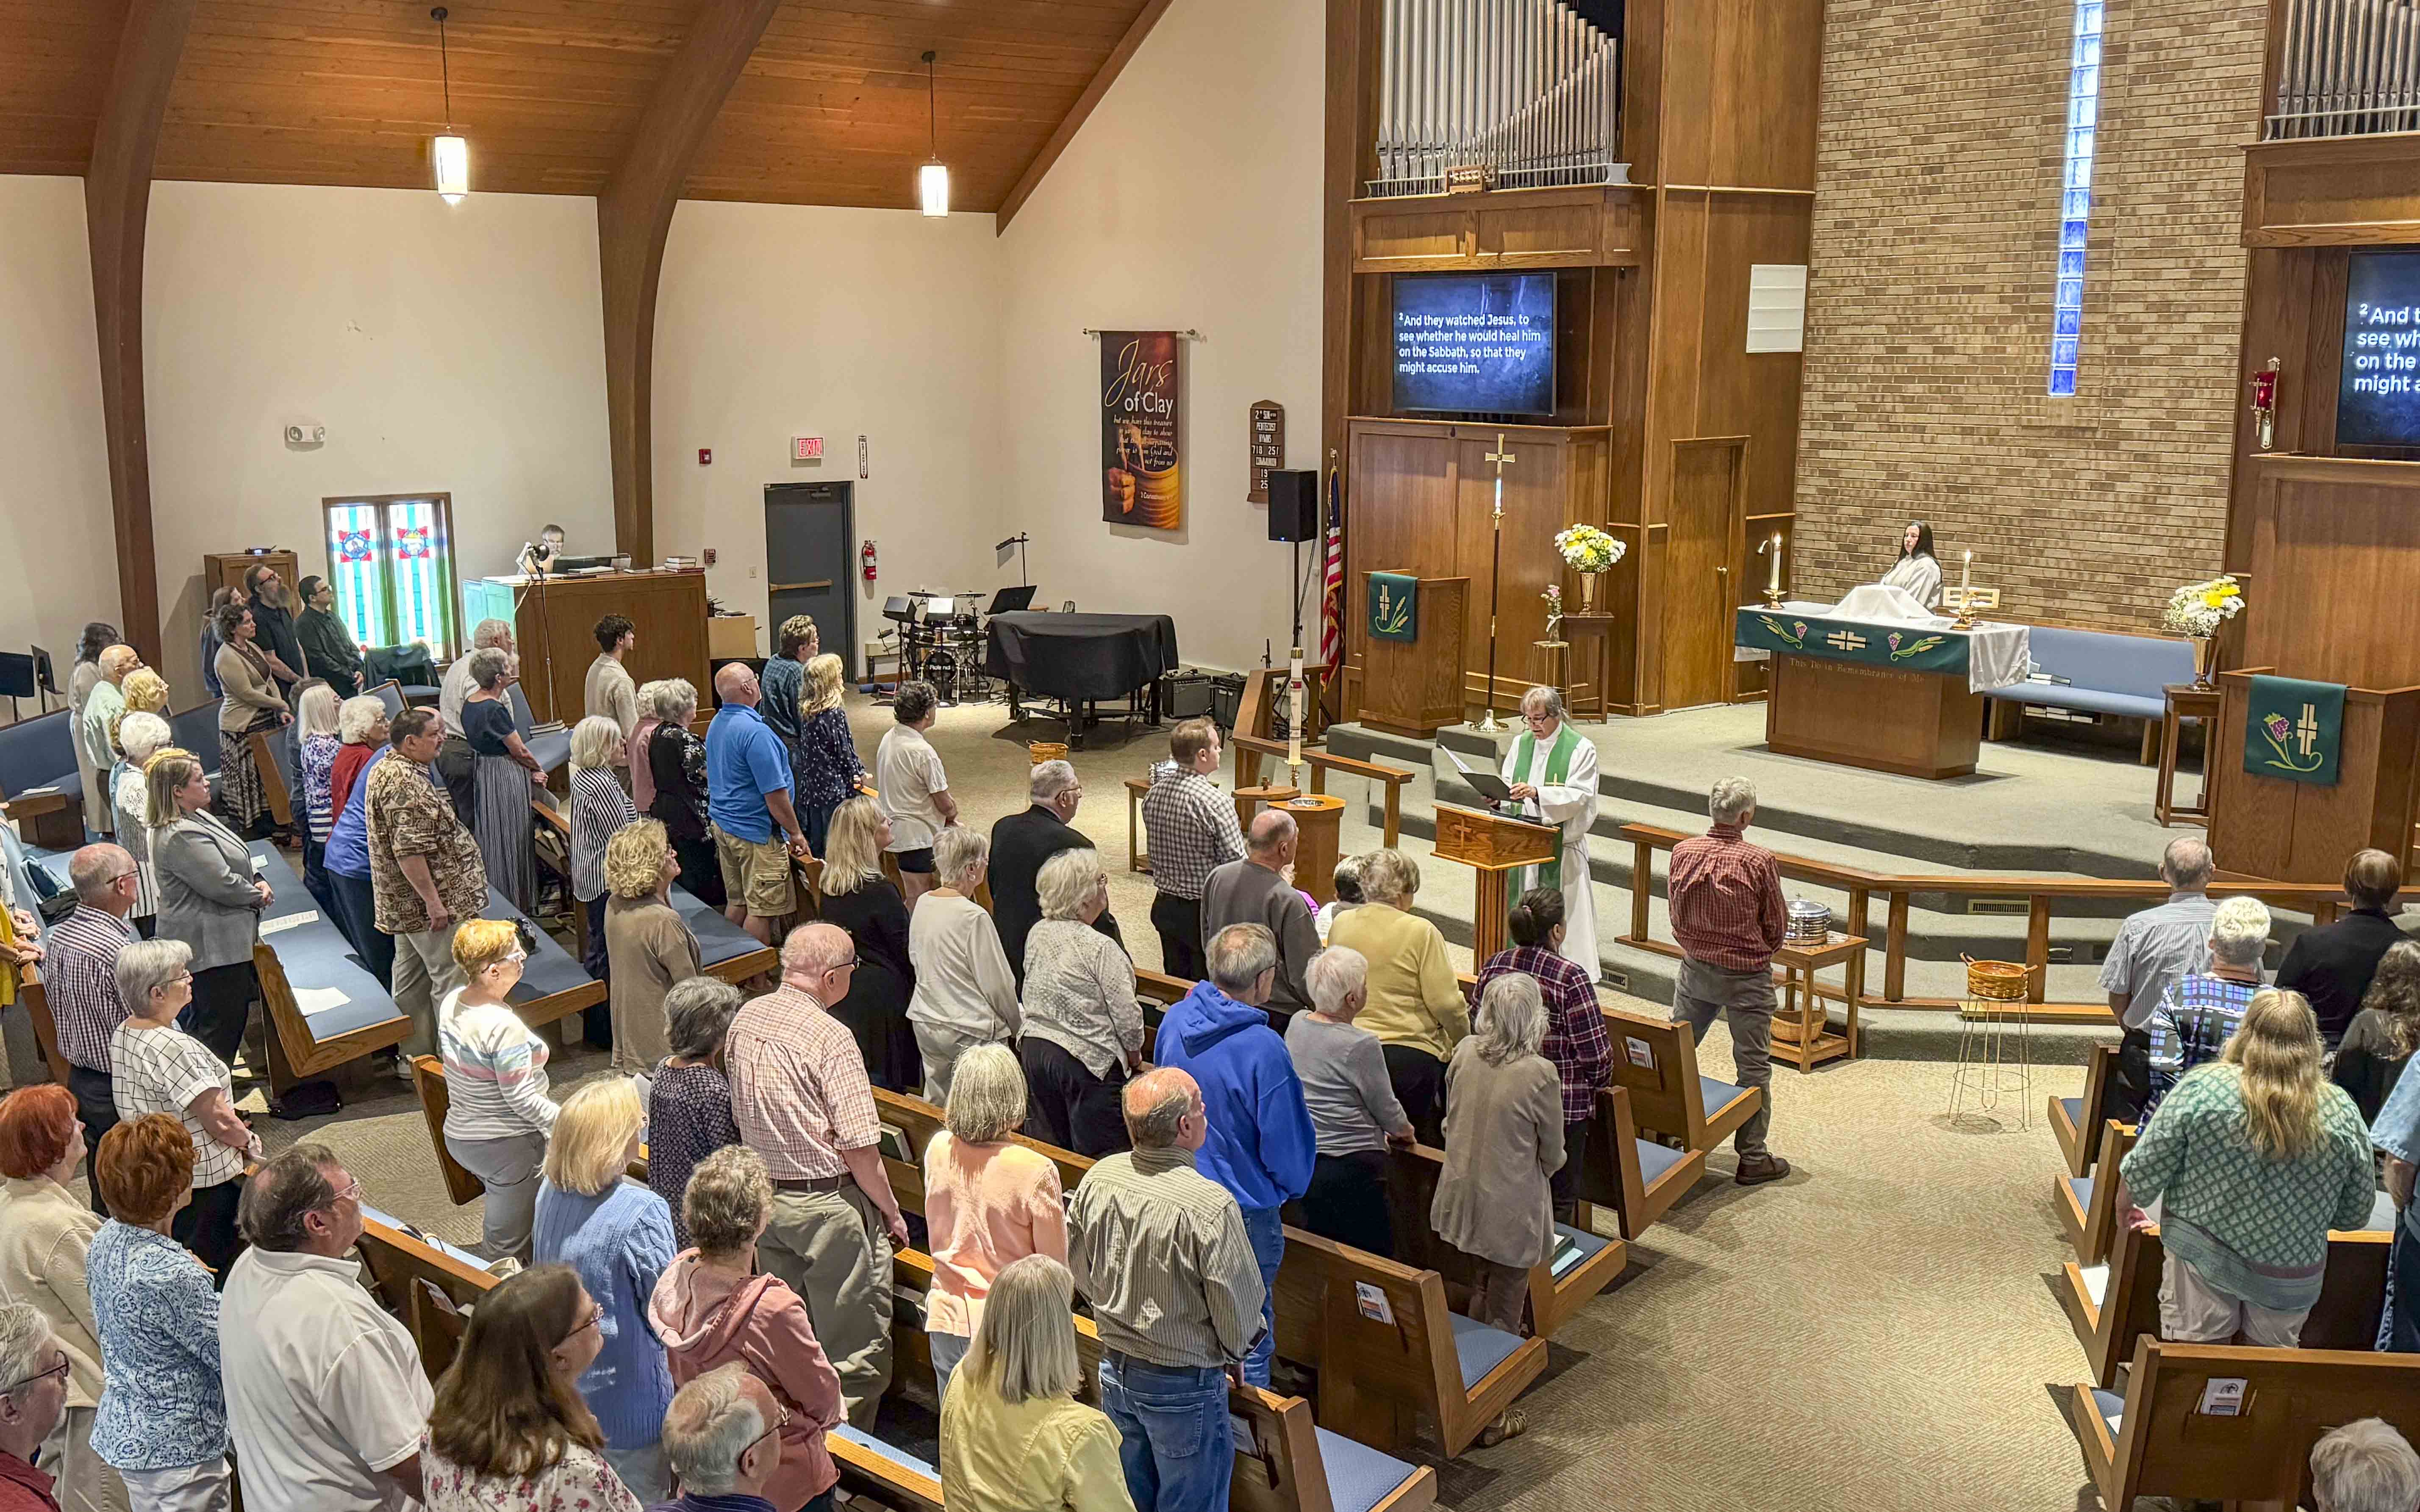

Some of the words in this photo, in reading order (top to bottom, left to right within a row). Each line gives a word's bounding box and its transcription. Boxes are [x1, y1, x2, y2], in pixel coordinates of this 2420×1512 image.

[1404, 314, 1422, 326] And
[1424, 314, 1444, 328] they
[1446, 314, 1485, 327] watched
[1488, 314, 1516, 327] Jesus,
[1519, 314, 1529, 325] to
[2369, 306, 2409, 325] And
[1399, 332, 1415, 342] see
[1416, 330, 1453, 342] whether
[1455, 330, 1467, 342] he
[1468, 330, 1497, 342] would
[1500, 330, 1519, 342] heal
[1522, 330, 1540, 342] him
[2357, 333, 2390, 346] see
[1399, 348, 1411, 357] on
[1413, 346, 1427, 357] the
[1429, 346, 1469, 359] Sabbath,
[1471, 348, 1481, 358] so
[1484, 346, 1503, 358] that
[1505, 346, 1526, 360] they
[1399, 361, 1425, 375] might
[1426, 363, 1457, 373] accuse
[1460, 362, 1480, 374] him.
[2356, 355, 2379, 370] on
[2385, 352, 2416, 370] the
[1105, 339, 1173, 407] Jars
[2355, 375, 2410, 394] might
[1124, 391, 1140, 412] of
[1142, 391, 1173, 420] Clay
[1256, 422, 1276, 431] PENTECOST
[799, 439, 822, 456] EXIT
[1252, 446, 1263, 454] 718
[1268, 446, 1279, 455] 251
[1789, 658, 1807, 668] This
[1825, 662, 1833, 671] in
